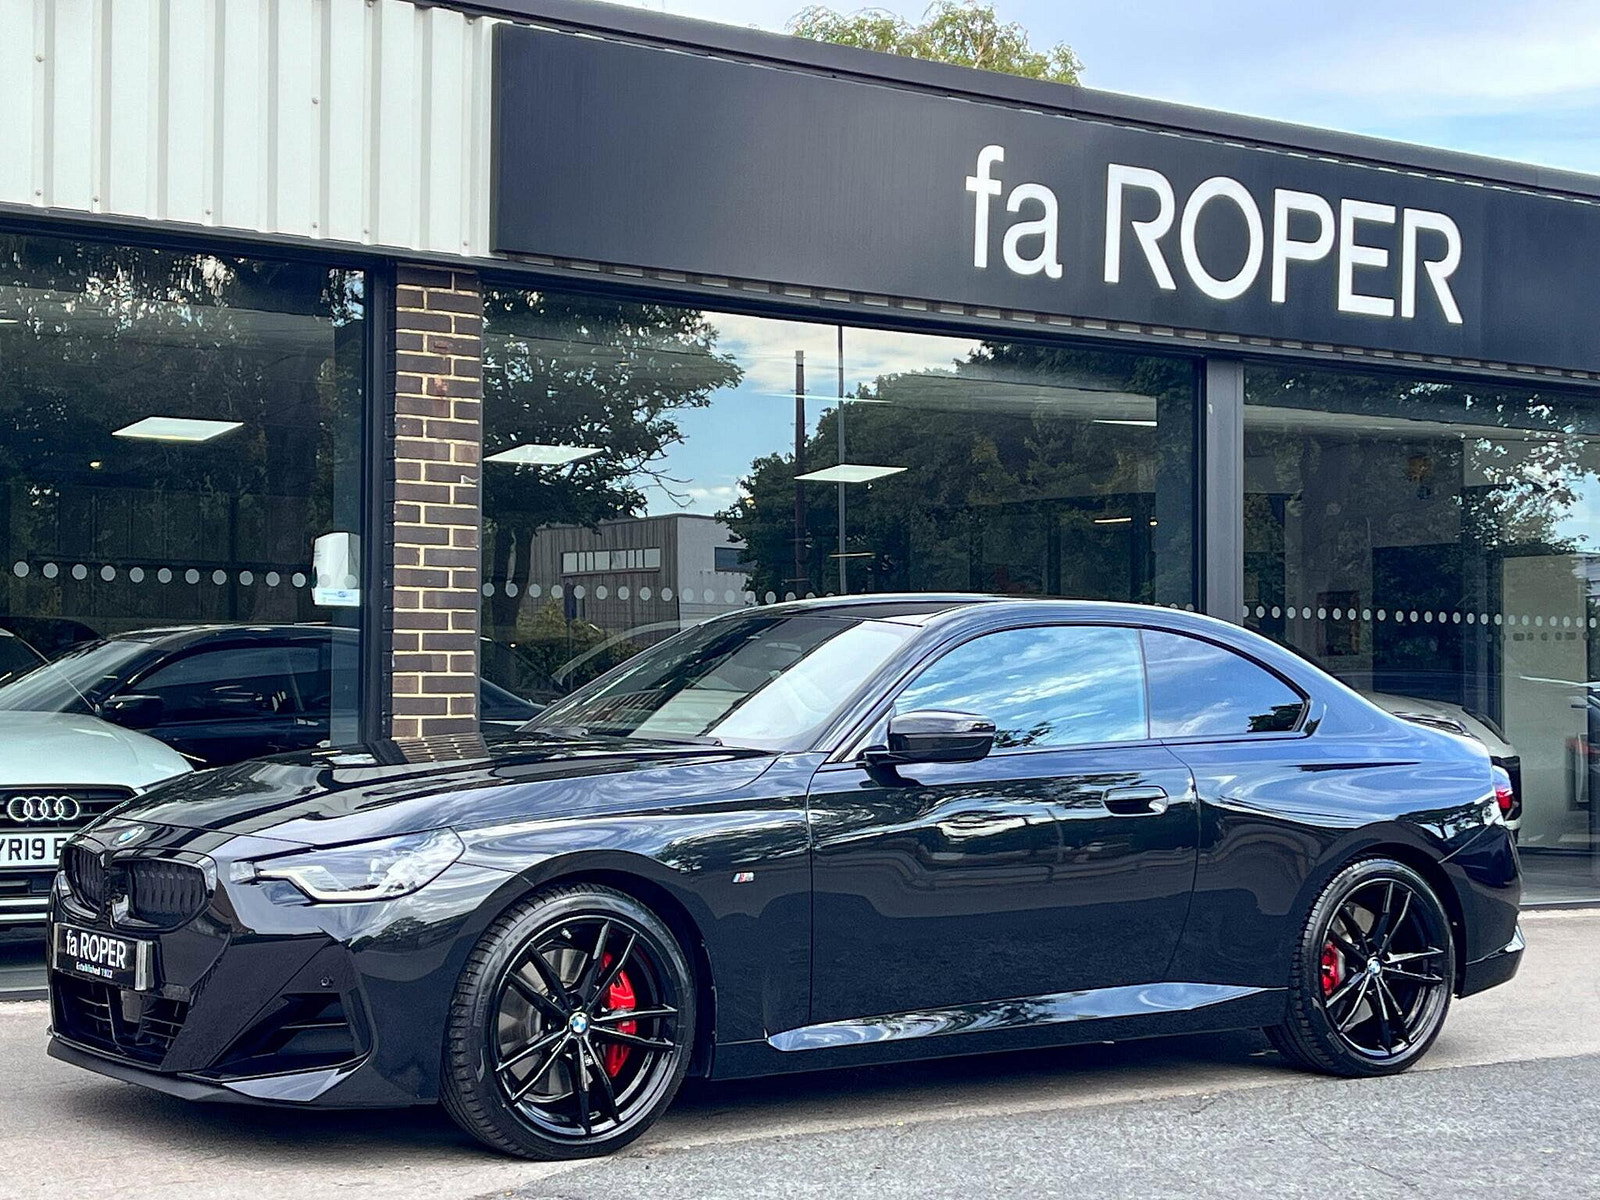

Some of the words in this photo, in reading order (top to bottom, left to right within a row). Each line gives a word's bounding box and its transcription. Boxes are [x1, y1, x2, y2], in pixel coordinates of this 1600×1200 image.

[965, 145, 1063, 279] fa
[1104, 163, 1463, 324] ROPER
[66, 929, 78, 957] fa
[80, 932, 127, 969] ROPER
